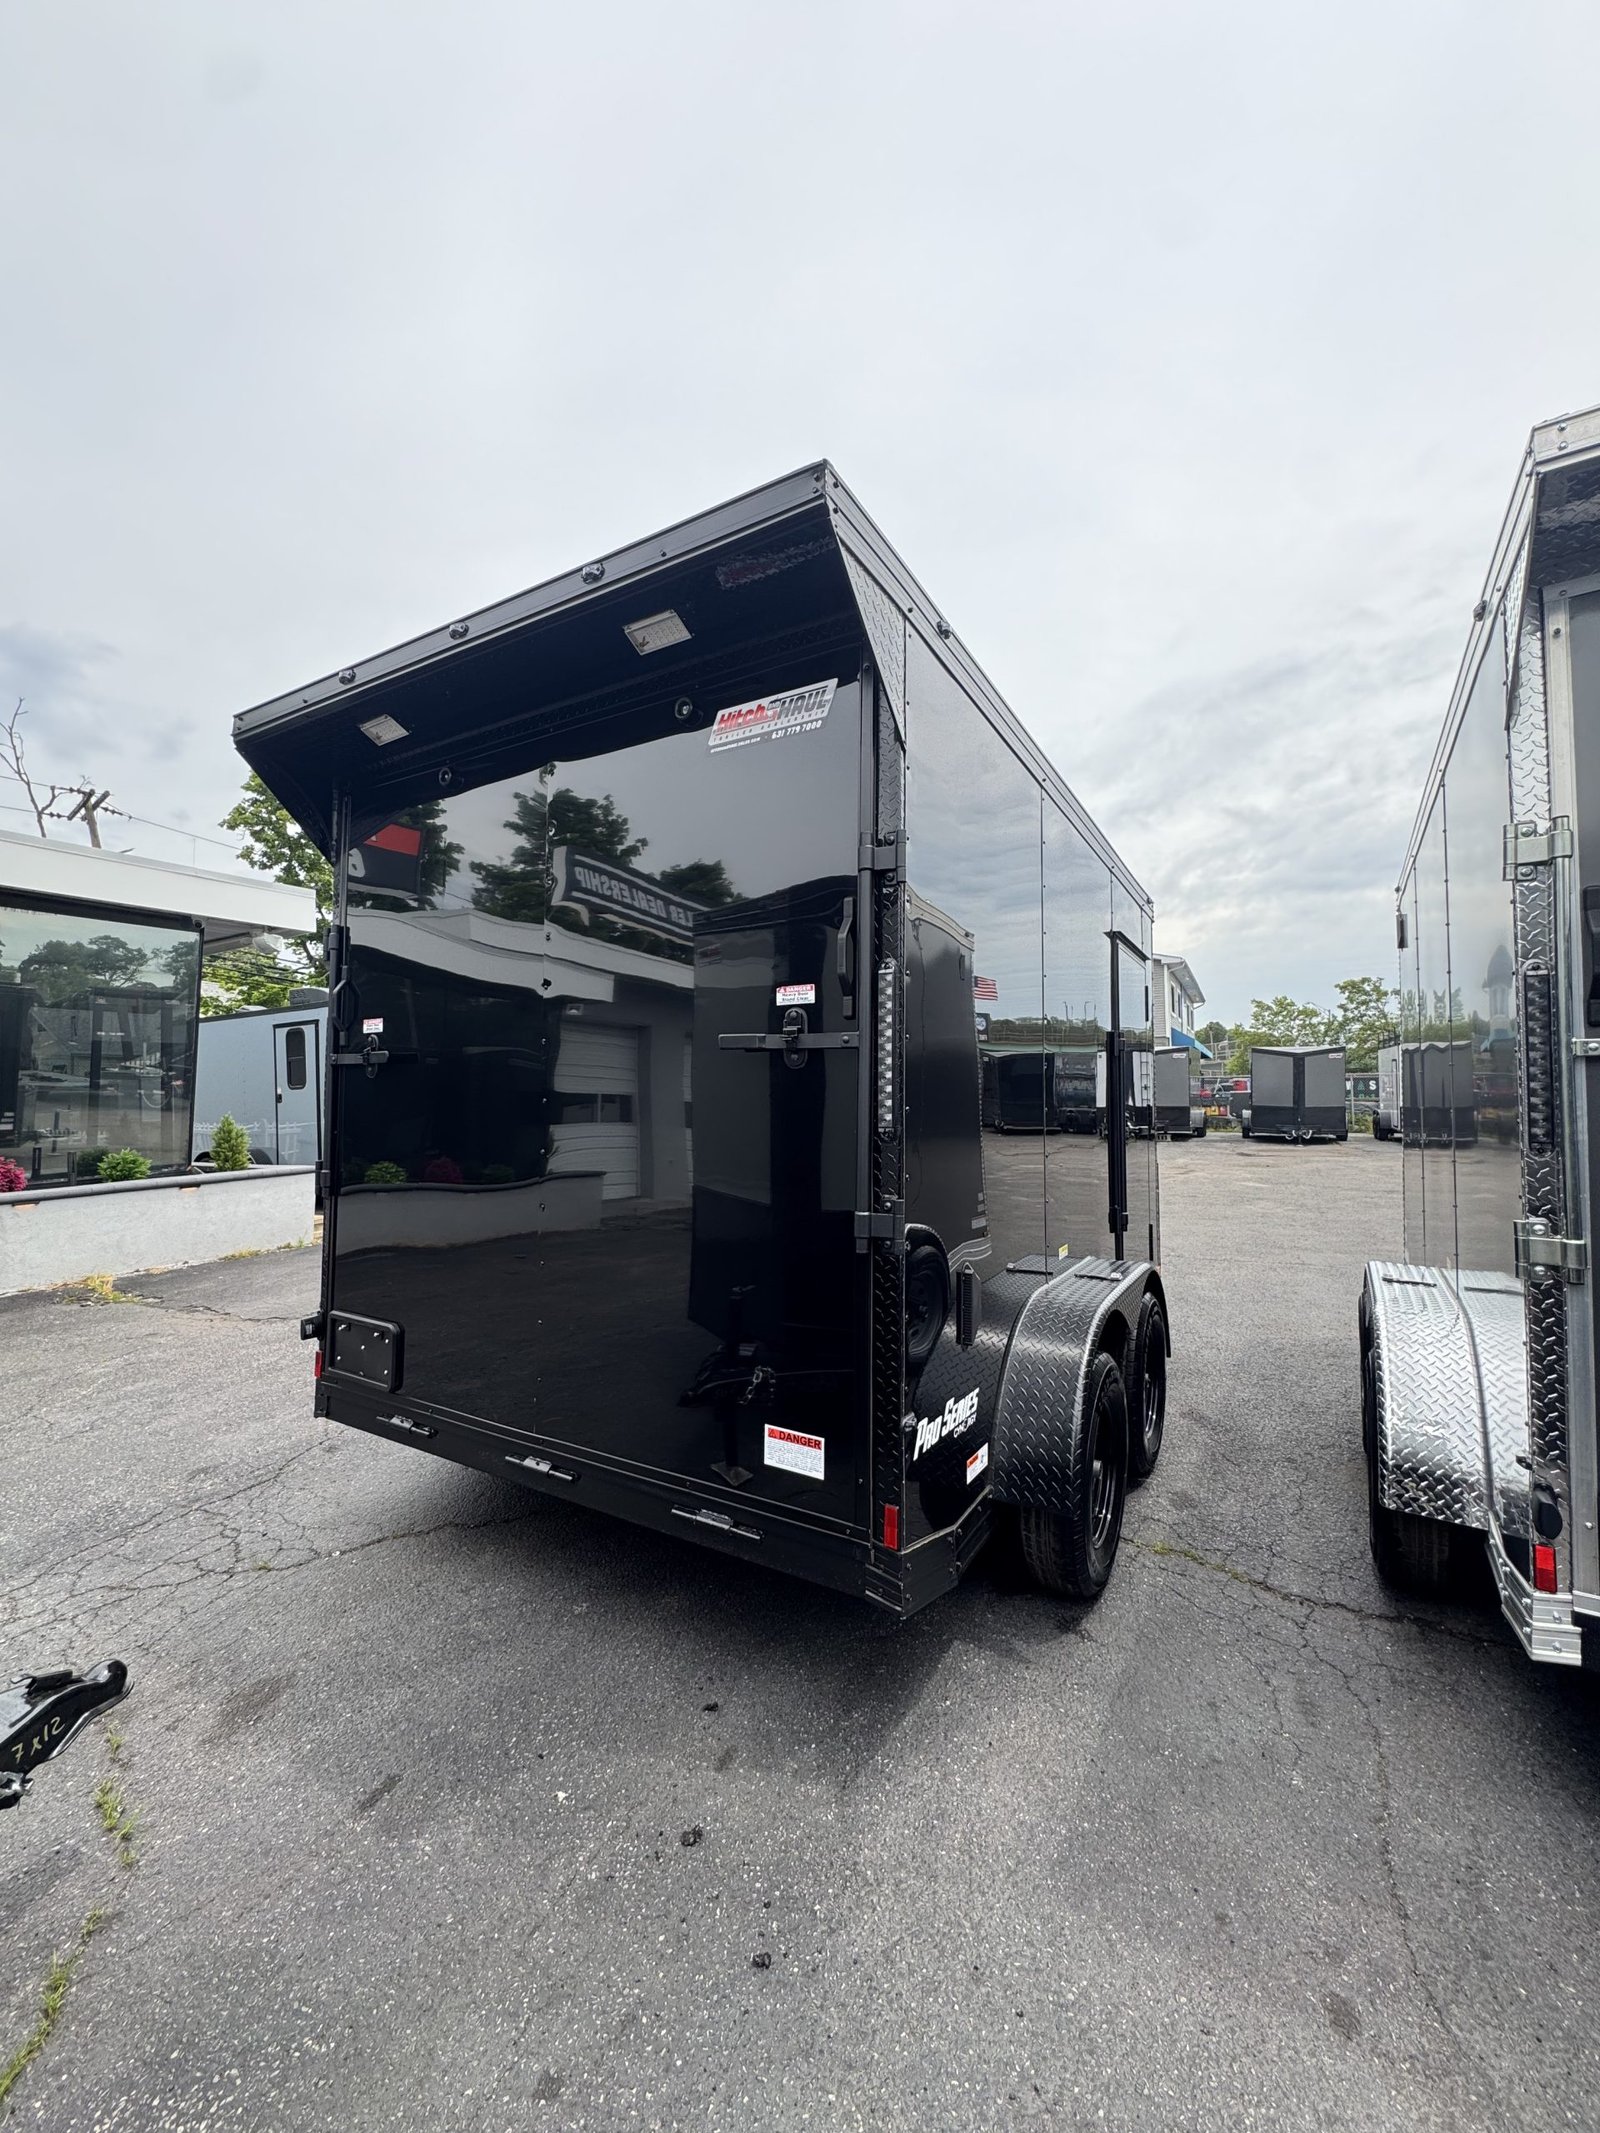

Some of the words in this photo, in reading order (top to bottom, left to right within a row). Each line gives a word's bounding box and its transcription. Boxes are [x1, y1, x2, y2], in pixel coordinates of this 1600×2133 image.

[717, 703, 767, 729] Hitch
[776, 689, 830, 720] HAUL
[771, 731, 786, 740] 631
[779, 1431, 822, 1450] DANGER
